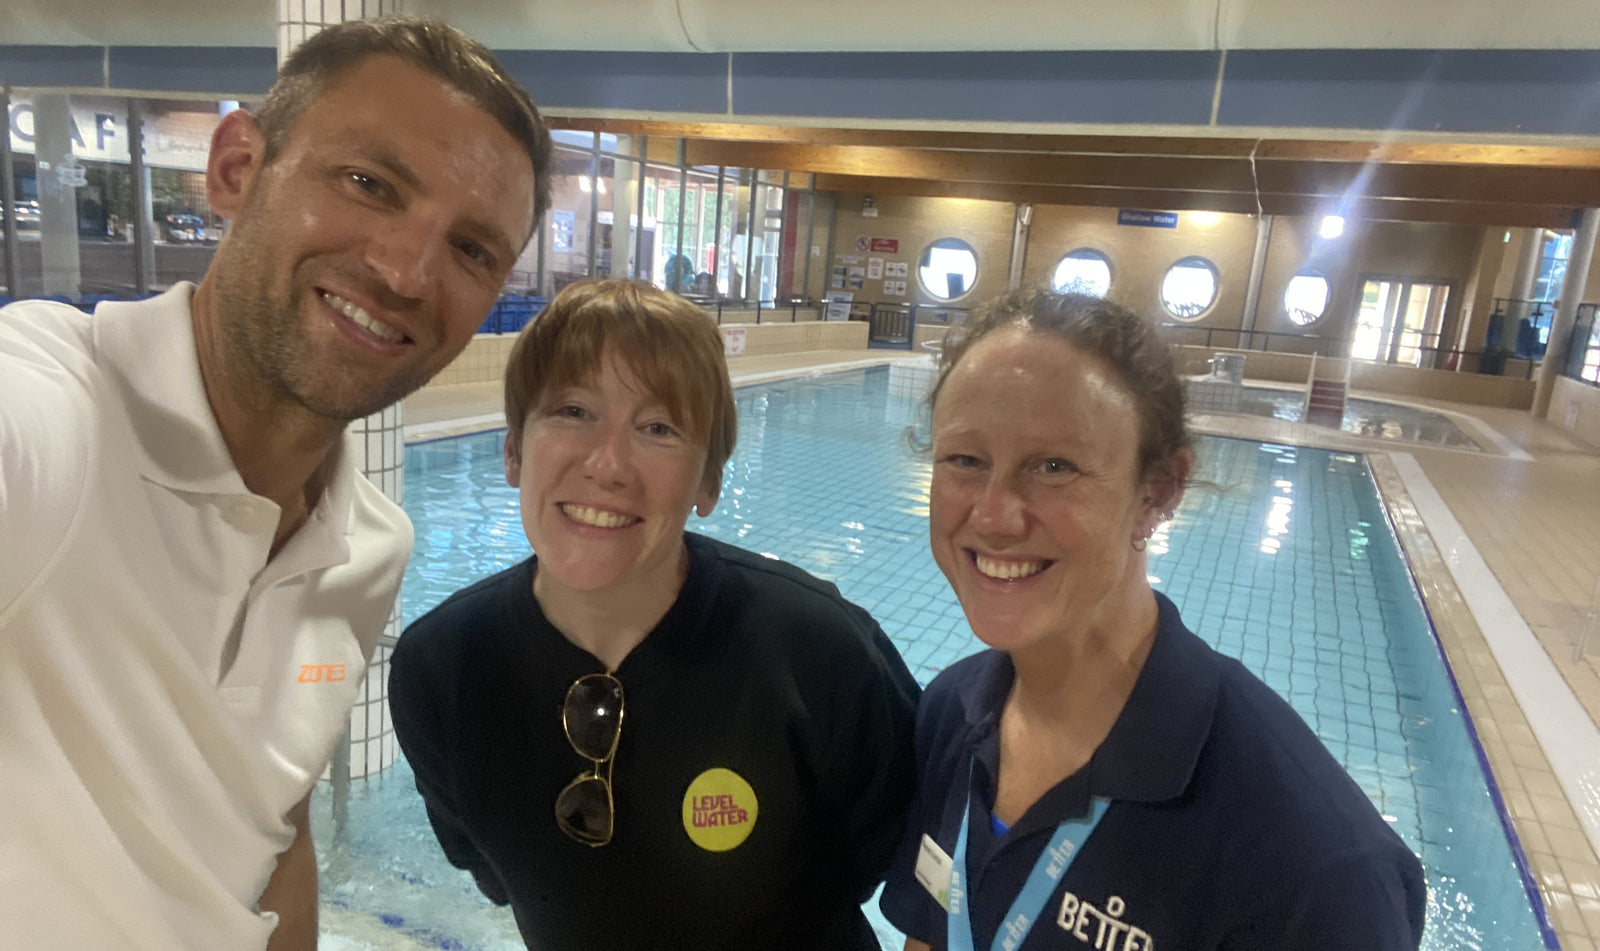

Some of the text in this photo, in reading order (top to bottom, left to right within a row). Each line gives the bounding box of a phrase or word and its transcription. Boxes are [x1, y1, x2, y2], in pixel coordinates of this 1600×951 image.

[1121, 213, 1175, 224] Shallow Water
[692, 794, 738, 811] LEVEL
[692, 808, 749, 828] WATER
